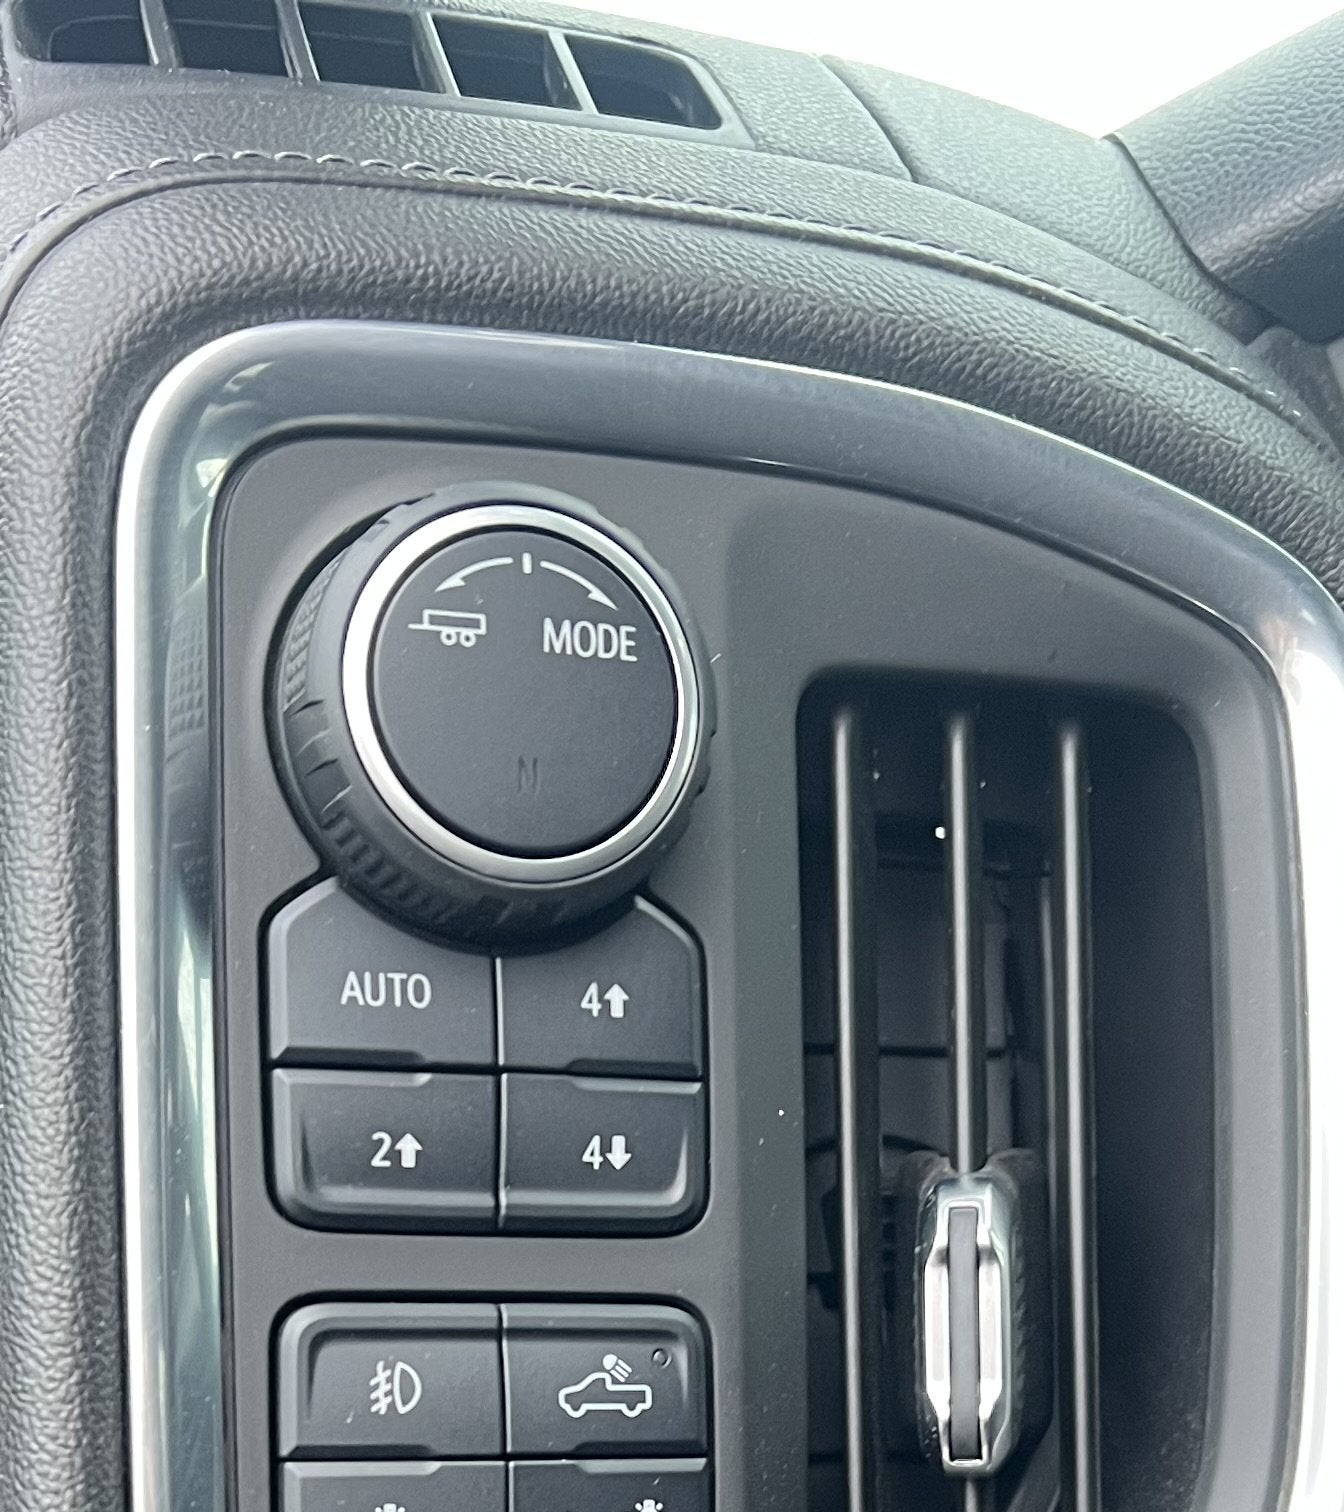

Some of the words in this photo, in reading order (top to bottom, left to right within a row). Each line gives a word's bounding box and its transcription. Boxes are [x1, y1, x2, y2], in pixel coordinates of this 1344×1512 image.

[543, 617, 638, 662] MODE
[340, 971, 432, 1009] AUTO
[580, 982, 602, 1018] 4
[370, 1131, 392, 1168] 2
[582, 1134, 604, 1170] 4
